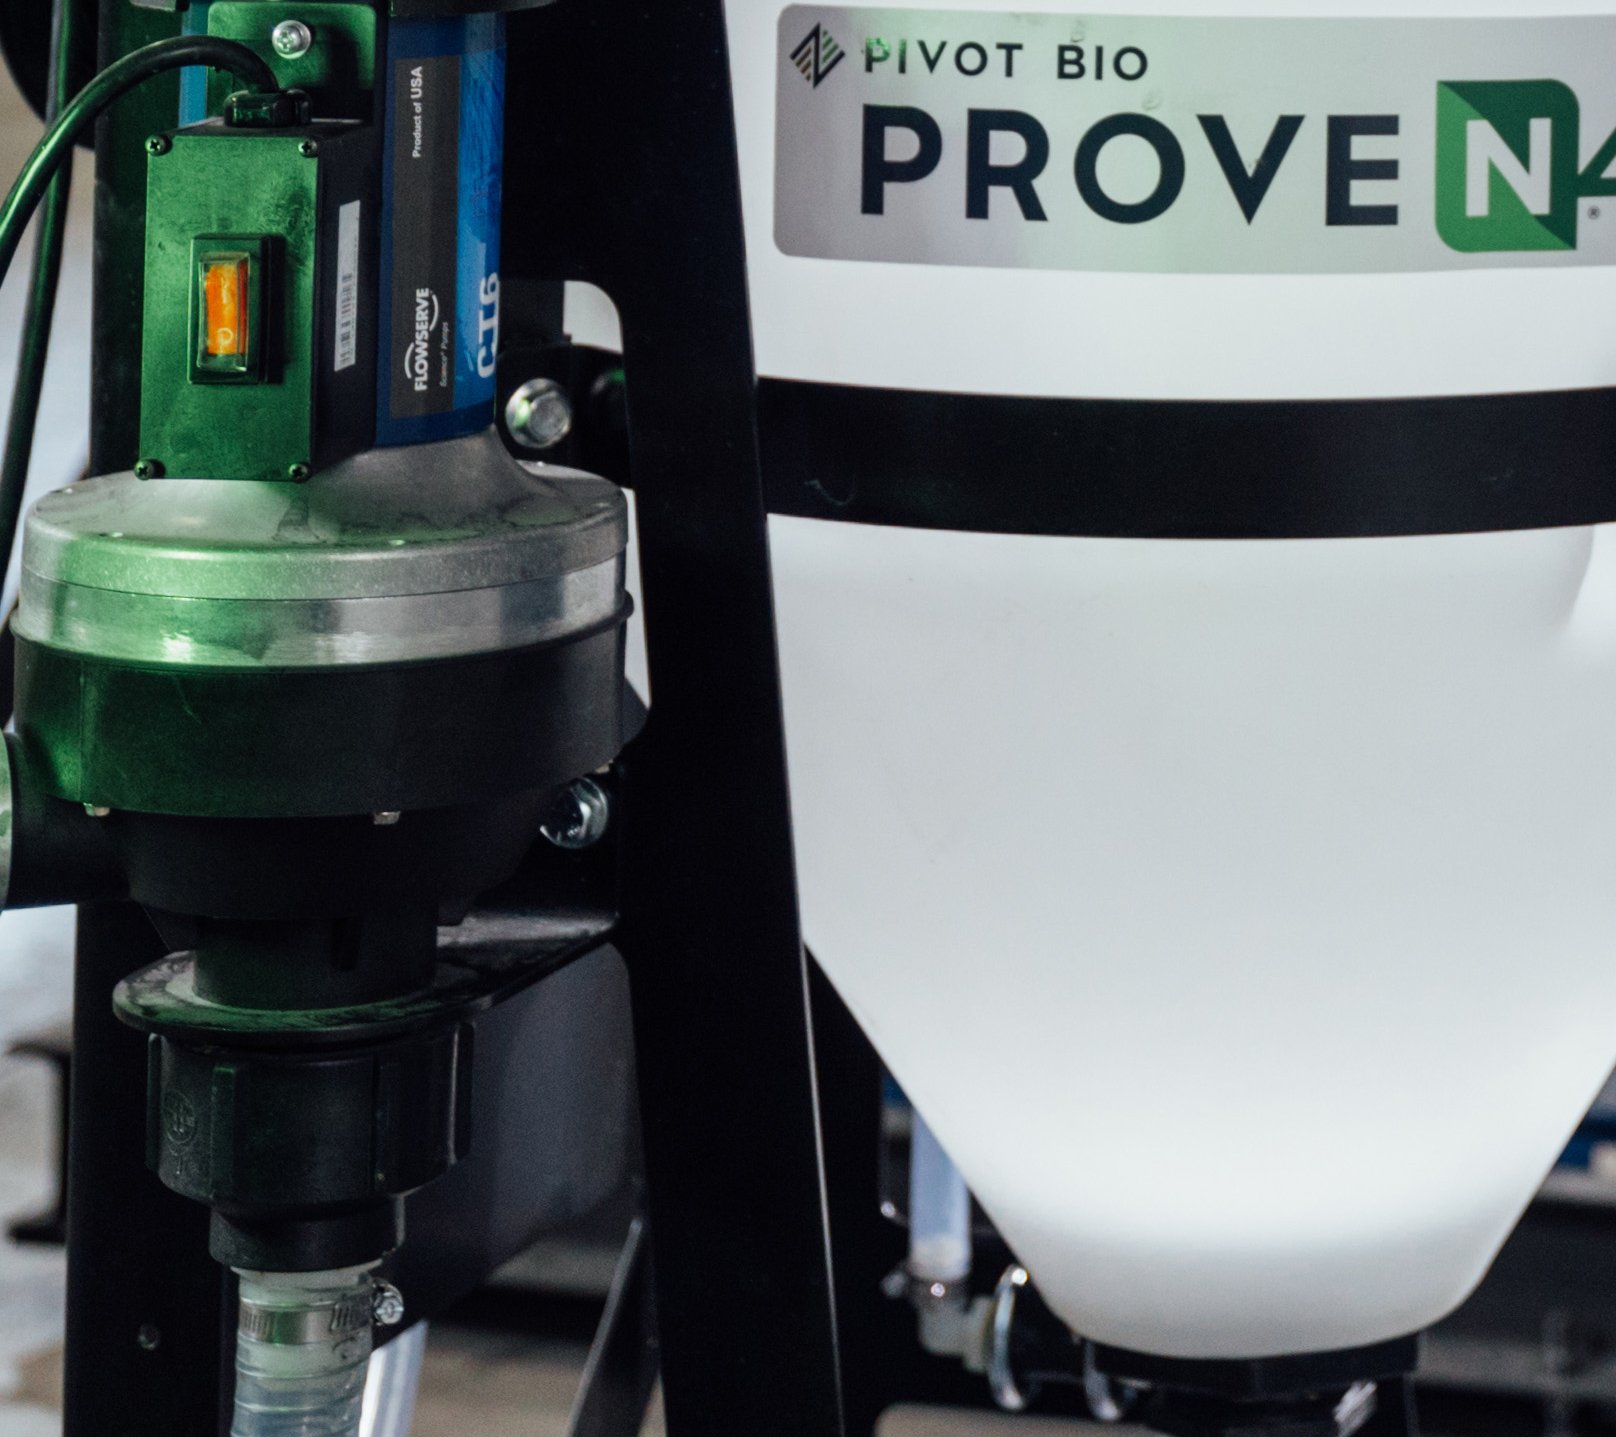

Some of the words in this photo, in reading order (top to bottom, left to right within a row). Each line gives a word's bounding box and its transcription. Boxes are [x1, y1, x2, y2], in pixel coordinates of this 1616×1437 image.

[409, 64, 424, 99] USA
[863, 38, 1023, 81] PIVOT
[1058, 42, 1150, 82] BIO
[411, 100, 423, 114] of
[411, 115, 423, 158] Product
[859, 103, 1400, 227] PROVE
[414, 287, 429, 391] FLOWSERVE
[440, 321, 449, 349] Pumps
